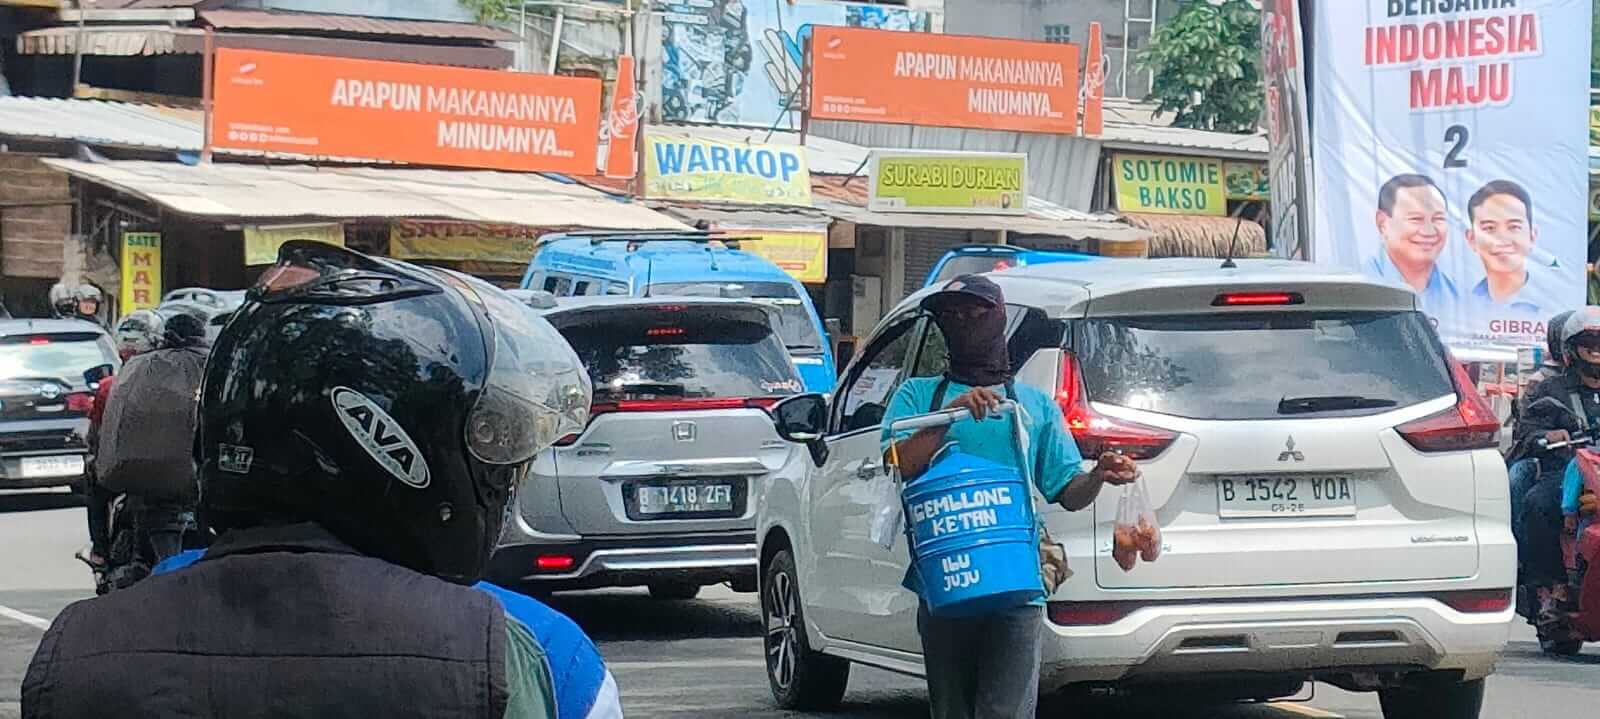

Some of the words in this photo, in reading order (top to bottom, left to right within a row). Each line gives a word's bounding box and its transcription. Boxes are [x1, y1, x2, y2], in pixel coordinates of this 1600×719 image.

[1364, 14, 1538, 65] INDONESIA
[895, 51, 957, 80] APAPUN
[959, 56, 1063, 88] MAKANANNYA
[331, 79, 421, 111] APAPUN
[426, 87, 577, 124] MAKANANNYA
[1409, 63, 1510, 109] MAJU
[968, 87, 1063, 119] MINUMNYA...
[437, 120, 575, 158] MINUMNYA...
[1443, 124, 1469, 169] 2
[655, 142, 800, 183] WARKOP
[883, 162, 948, 188] SURABI
[951, 165, 1020, 191] DURIAN
[1122, 159, 1219, 184] SOTOMIE
[1139, 186, 1207, 210] BAKSO
[127, 235, 160, 248] SATE
[132, 252, 152, 306] MAR
[1489, 319, 1546, 334] GIBRA
[343, 404, 417, 477] AVA
[639, 487, 649, 504] B
[662, 486, 697, 505] 1418
[1221, 479, 1236, 502] B
[932, 508, 997, 536] KETAN
[943, 569, 980, 592] JUJU
